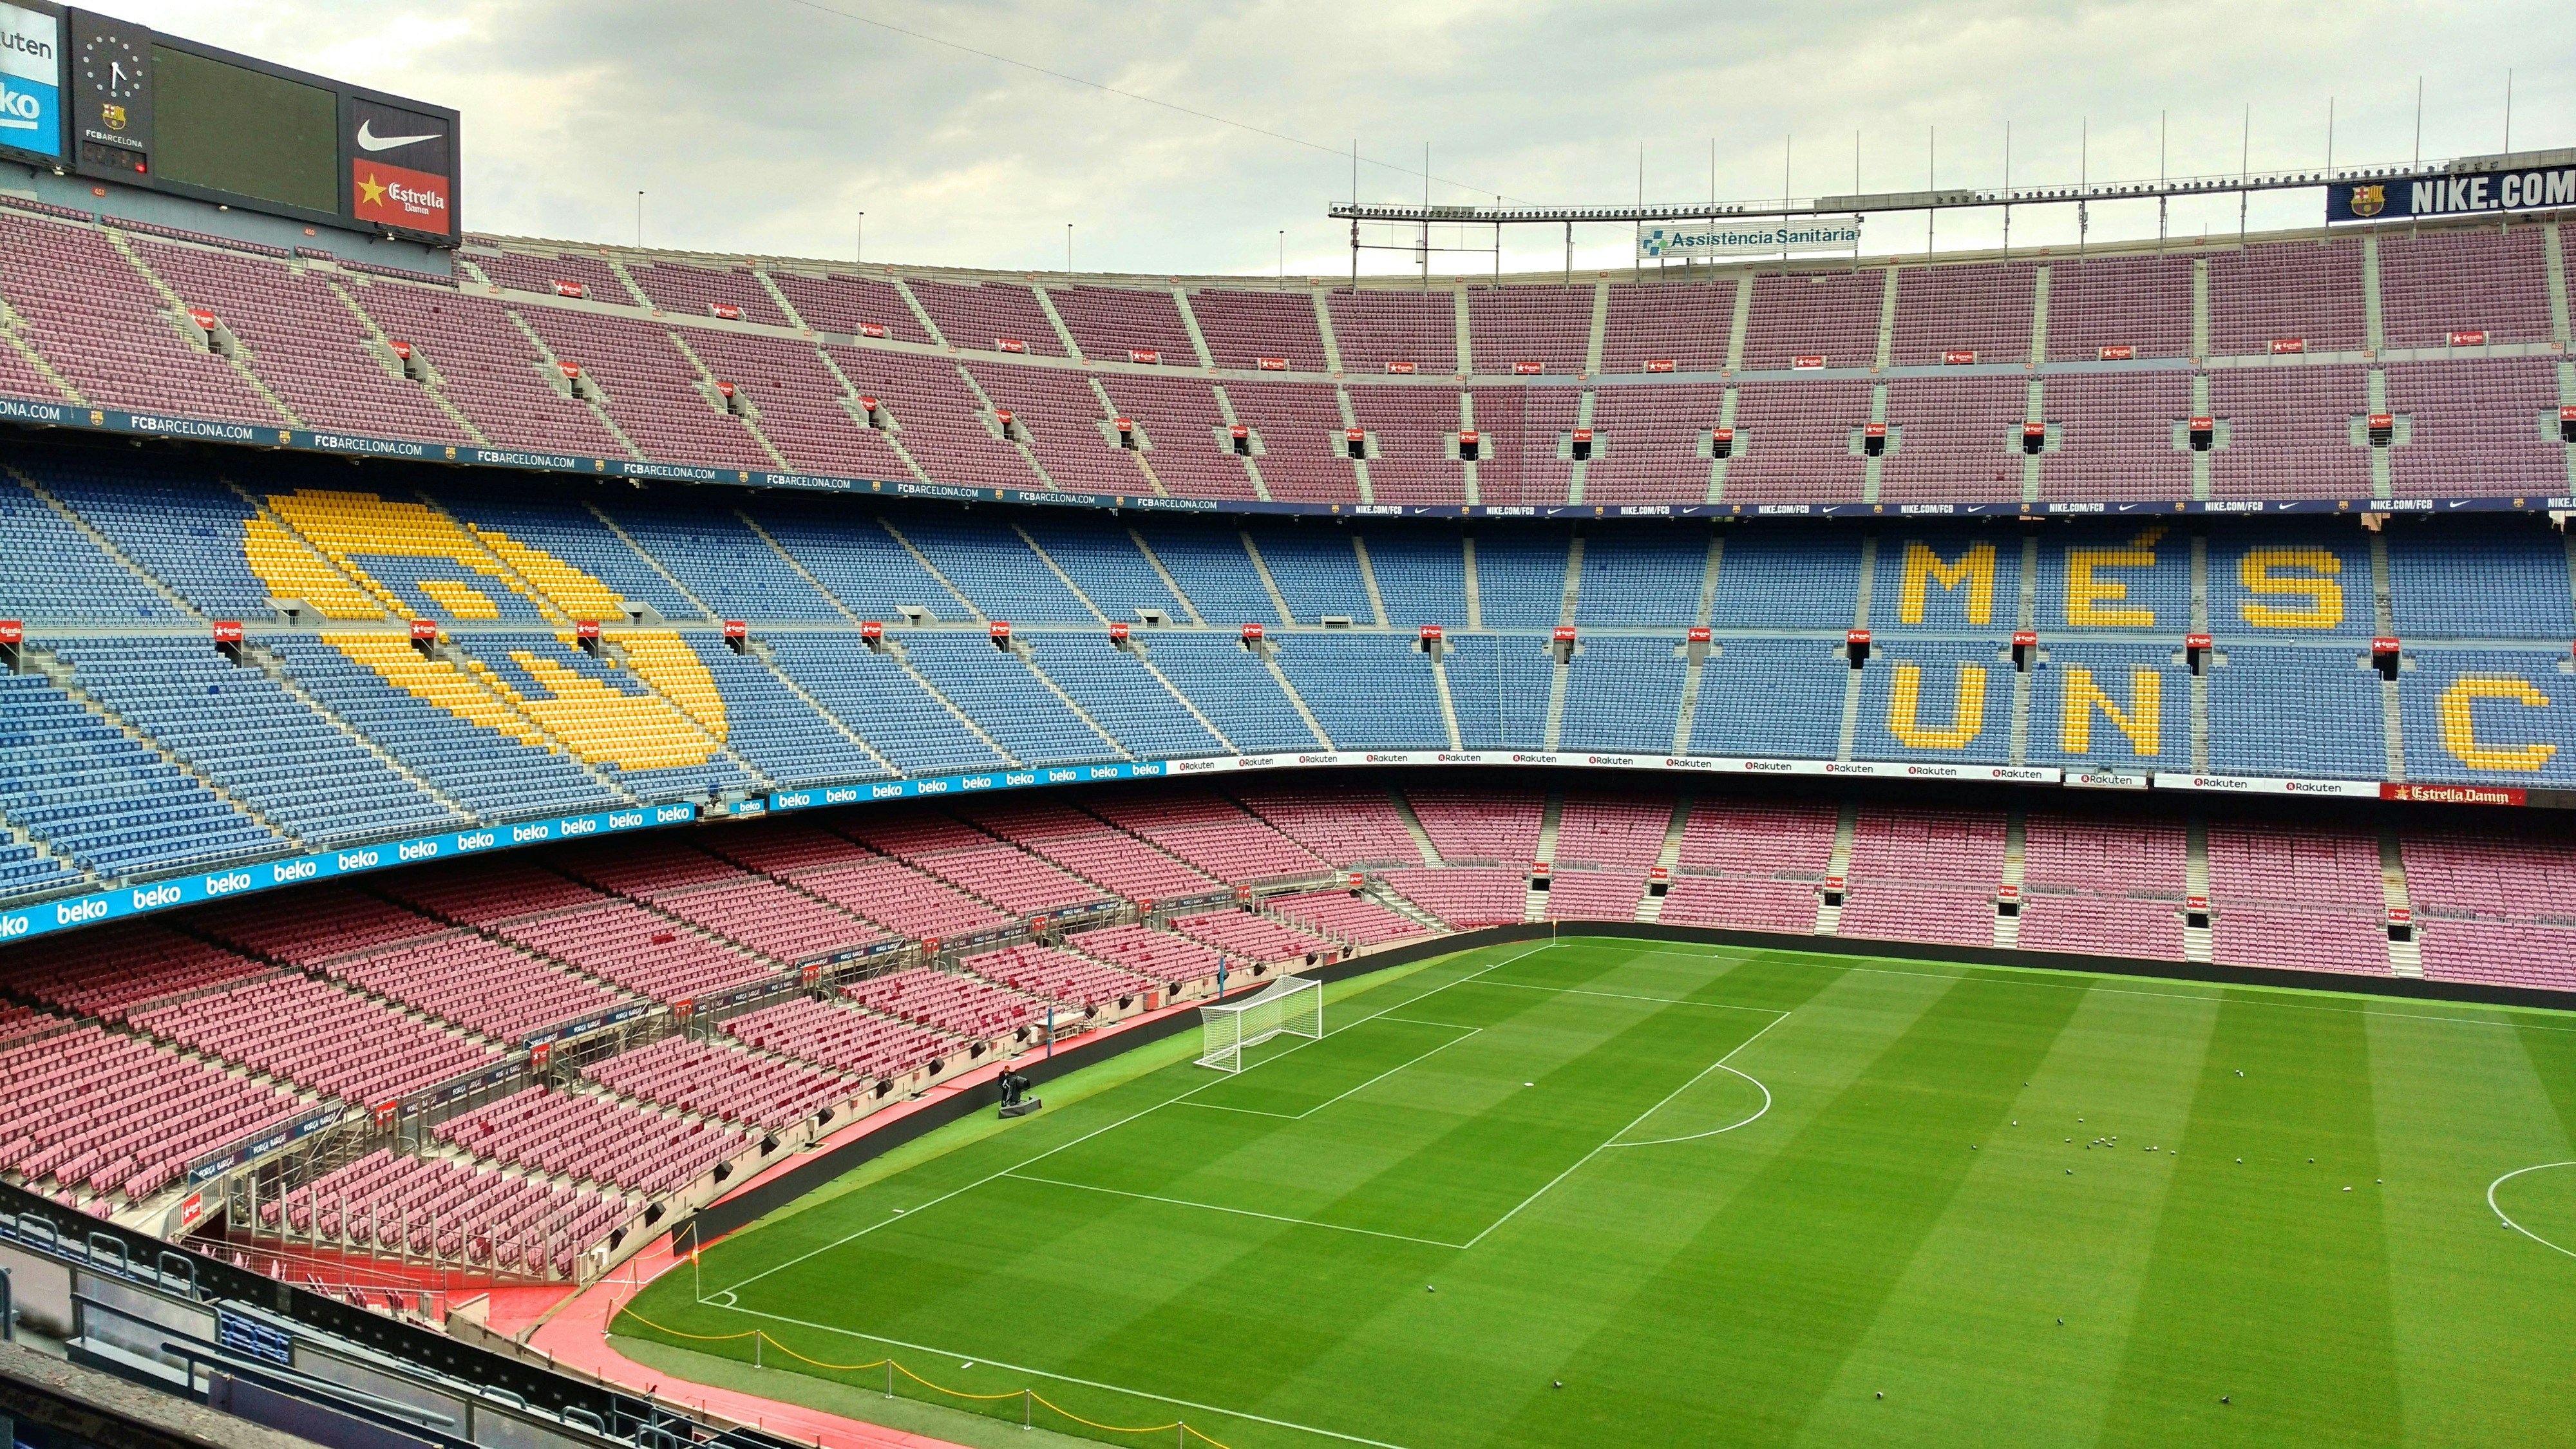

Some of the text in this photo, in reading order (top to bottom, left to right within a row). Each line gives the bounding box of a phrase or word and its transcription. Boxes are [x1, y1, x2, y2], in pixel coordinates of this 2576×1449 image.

[0, 32, 52, 59] uten
[86, 129, 143, 148] FCBARCELONA
[388, 182, 444, 209] Estrella
[2411, 170, 2576, 214] NIKE.COM
[404, 202, 429, 214] Damm
[1672, 227, 1855, 247] Assistència Sanitària
[131, 415, 252, 440] FCBARCELONA.COM
[315, 435, 422, 456] FCBARCELONA.COM
[478, 451, 574, 468] FCBARCELONA.COM
[624, 463, 715, 479] FCBARCELONA.COM
[766, 474, 850, 489] FCBARCELONA.COM
[898, 483, 978, 498] FCBARCELONA.COM
[1019, 491, 1095, 504] FCBARCELONA.COM
[1137, 498, 1217, 509] FCBARCELONA.COM
[1356, 506, 1402, 514] NIKE.COM/FCB
[1621, 506, 1669, 515] NIKE.COM/FCB
[1759, 505, 1809, 513] NIKE.COM/FCB
[1901, 505, 1953, 513] NIKE.COM/FCB
[2050, 504, 2104, 512] NIKE.COM/FCB
[2206, 502, 2263, 511] NIKE.COM/FCB
[2371, 500, 2432, 509] NIKE.COM/FCB
[1900, 526, 2344, 629] MÉS
[1891, 666, 2557, 770] UN C
[1133, 764, 1159, 775] beko
[1674, 759, 1711, 768] Rakuten
[1835, 764, 1873, 773] Rakuten
[1007, 773, 1034, 785] beko
[1050, 770, 1076, 781] beko
[1092, 766, 1117, 778] beko
[2002, 770, 2041, 778] Rakuten
[918, 781, 947, 793] beko
[963, 777, 991, 789] beko
[2090, 775, 2132, 786] Rakuten
[2204, 779, 2247, 788] Rakuten
[2297, 783, 2341, 791] Rakuten
[827, 789, 857, 802] beko
[873, 784, 902, 797] beko
[2411, 785, 2509, 803] Estrella Damm
[740, 802, 760, 811] beko
[779, 793, 810, 808] beko
[610, 813, 642, 828] beko
[658, 807, 689, 822] beko
[514, 824, 548, 841] beko
[562, 819, 596, 835] beko
[459, 833, 494, 850] beko
[400, 841, 437, 860] beko
[339, 851, 378, 870] beko
[274, 861, 316, 882] beko
[207, 873, 251, 895] beko
[134, 886, 180, 909] beko
[57, 900, 107, 924] beko
[469, 1078, 482, 1089] ARÇA!
[253, 1133, 287, 1155] FORÇA BARÇA!
[198, 1155, 234, 1177] FORÇA BARÇA!
